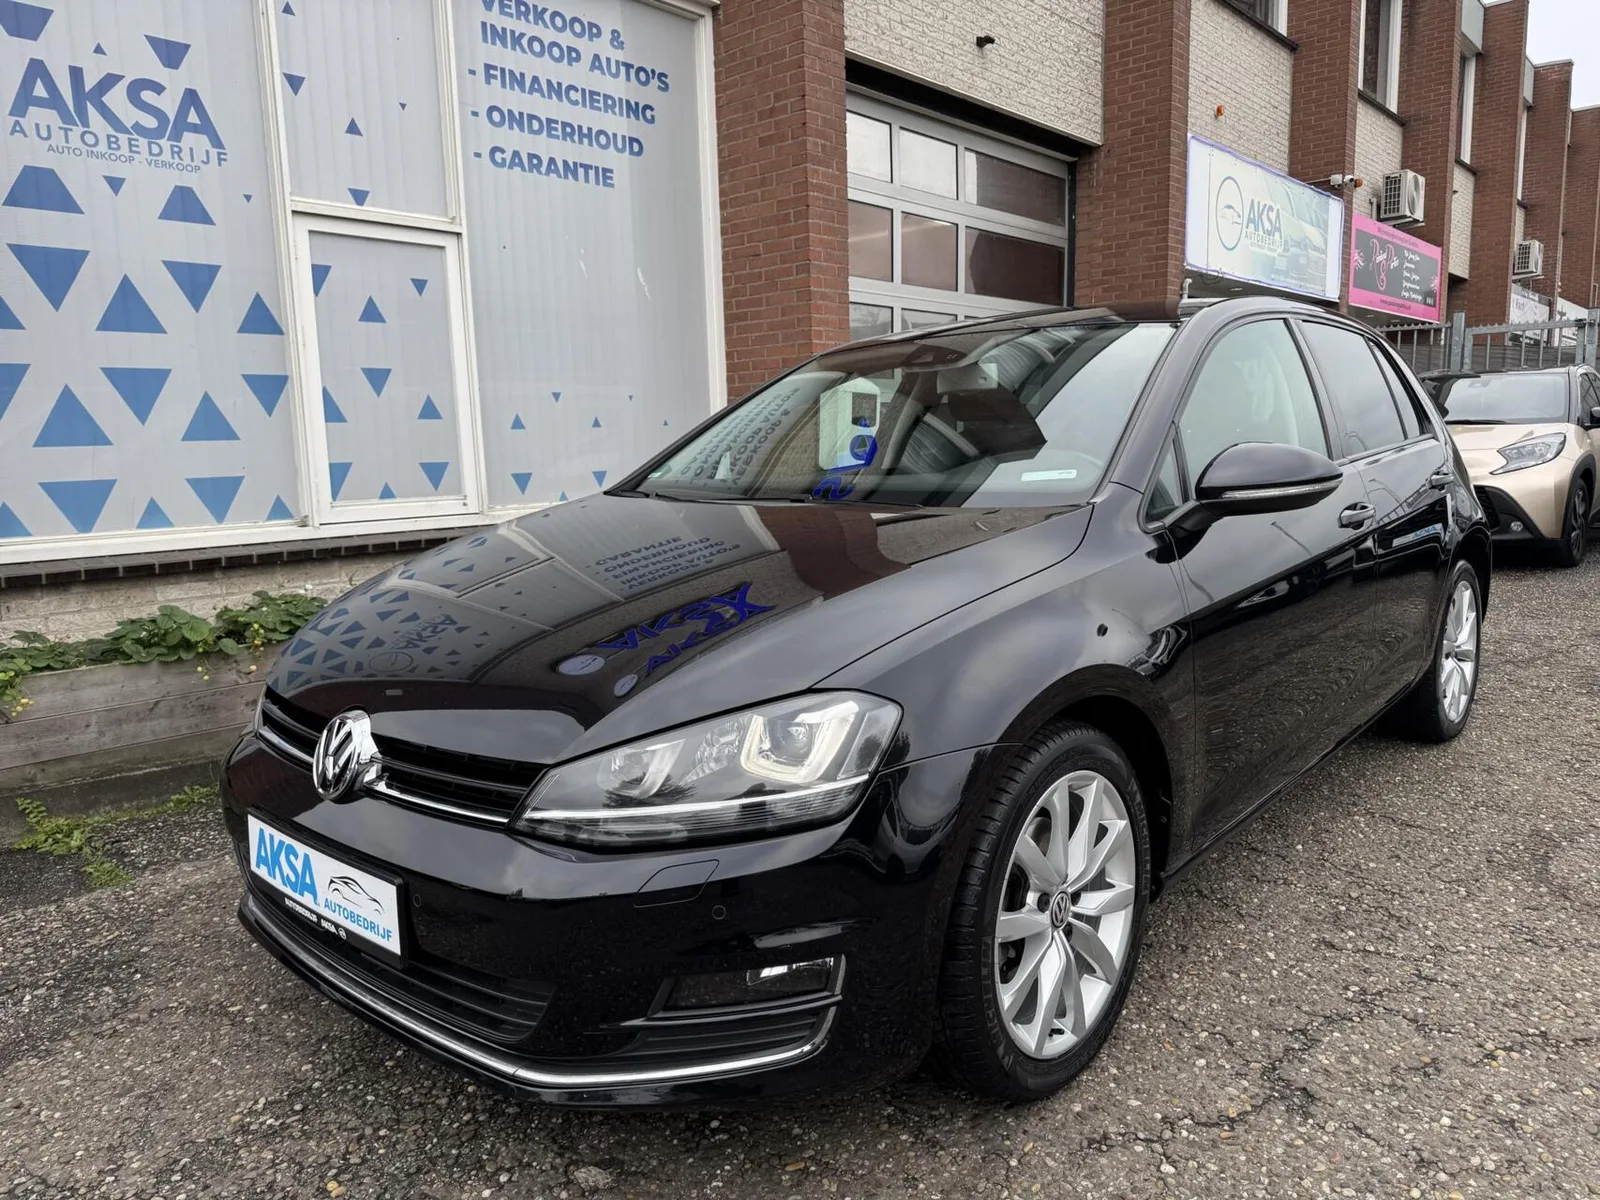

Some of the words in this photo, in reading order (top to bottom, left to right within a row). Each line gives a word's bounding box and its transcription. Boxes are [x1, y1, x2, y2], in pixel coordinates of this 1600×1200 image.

[480, 0, 602, 41] VERKOOP
[609, 29, 625, 51] &
[481, 21, 582, 67] INKOOP
[588, 53, 670, 93] AUTO'S
[8, 57, 226, 150] AKSA
[483, 62, 656, 125] FINANCIERING
[9, 120, 228, 167] AUTOBEDRIJF
[486, 105, 644, 157] ONDERHOUD
[47, 143, 83, 157] AUTO
[86, 150, 135, 164] INKOOP
[145, 158, 201, 173] VERKOOP
[488, 145, 615, 189] GARANTIE
[1245, 198, 1283, 241] AKSA
[255, 827, 318, 906] AKSA
[324, 898, 392, 942] AUTOBEDRIJF
